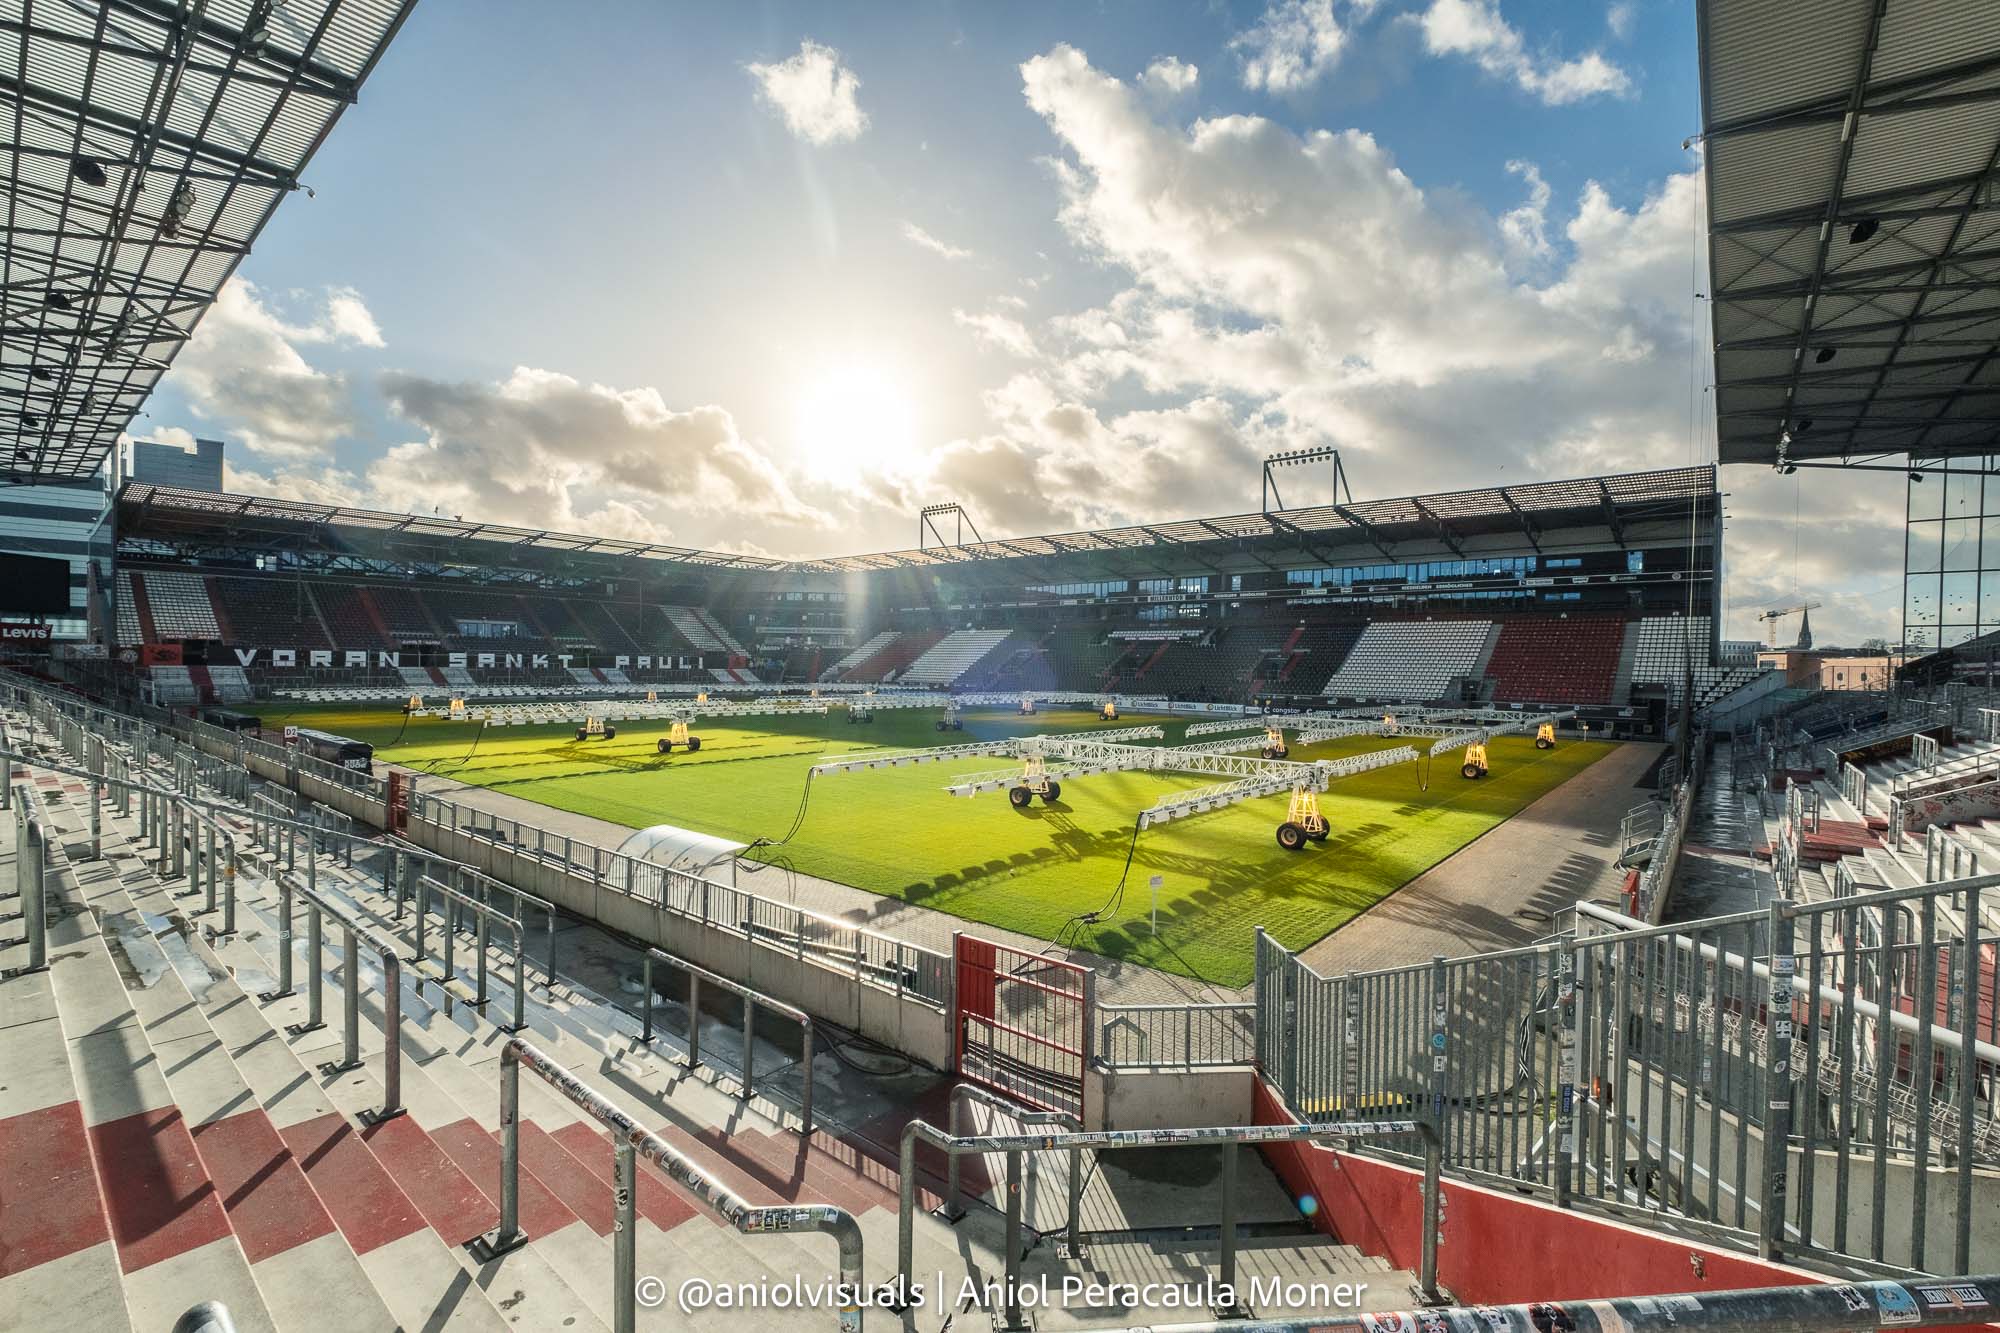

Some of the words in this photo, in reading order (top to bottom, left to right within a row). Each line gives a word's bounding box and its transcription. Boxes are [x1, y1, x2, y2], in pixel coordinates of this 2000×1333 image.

[2, 627, 48, 639] Levi's
[234, 648, 399, 668] VORAN
[448, 652, 574, 669] SANKT
[615, 654, 704, 670] PAULI
[1214, 704, 1238, 712] LichtBlick
[286, 727, 297, 736] D2
